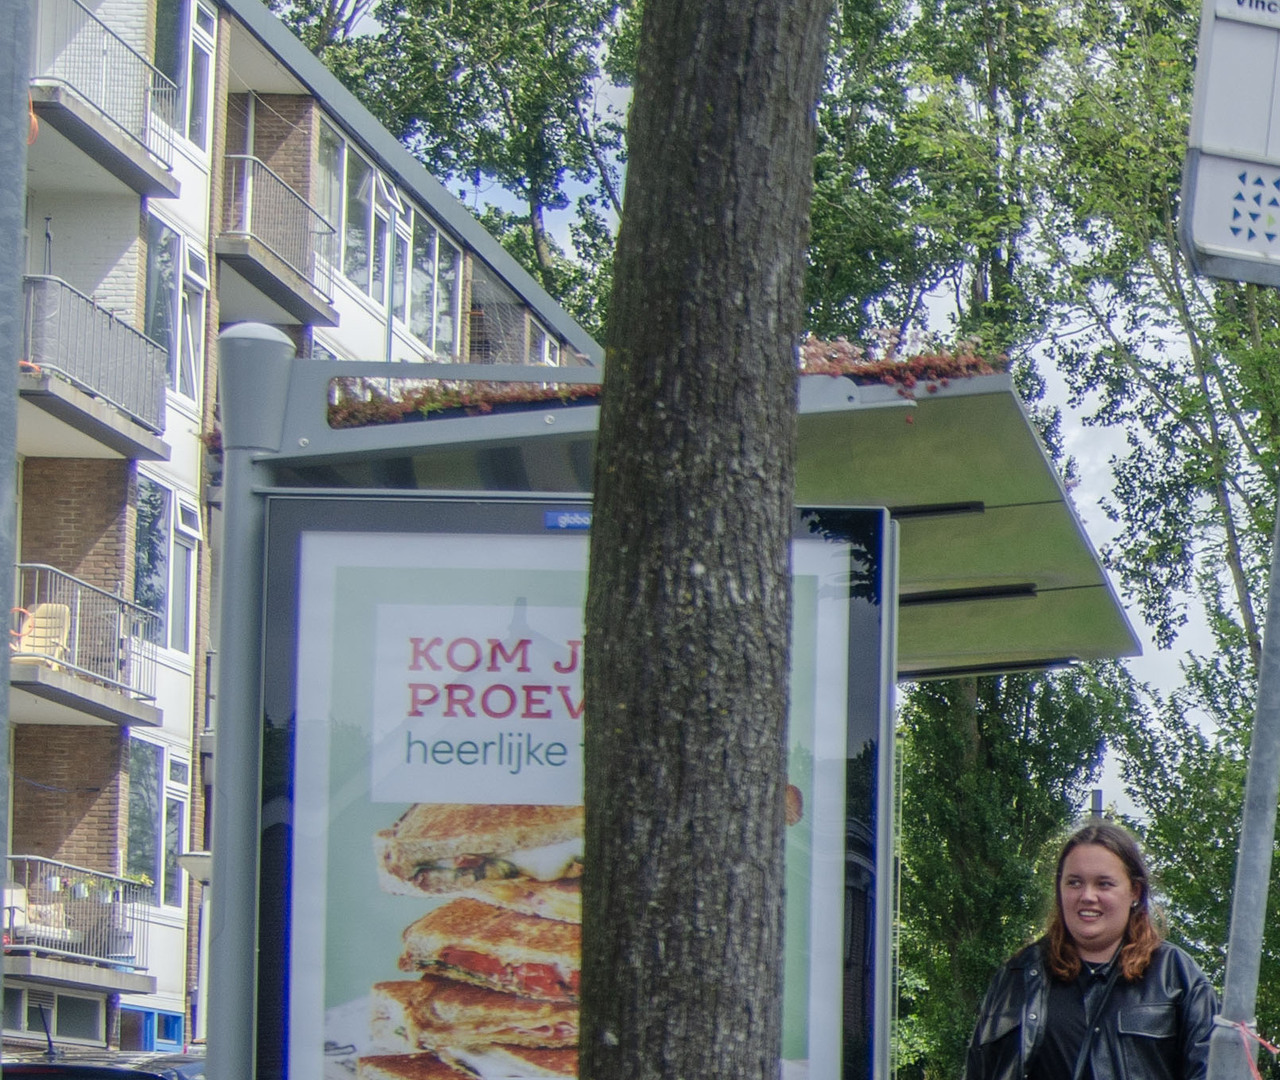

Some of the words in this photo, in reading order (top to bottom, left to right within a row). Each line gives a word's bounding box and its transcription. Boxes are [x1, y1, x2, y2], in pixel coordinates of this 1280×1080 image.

[408, 637, 533, 673] KOM
[407, 683, 586, 720] PROEV
[406, 731, 568, 775] heerlijke
